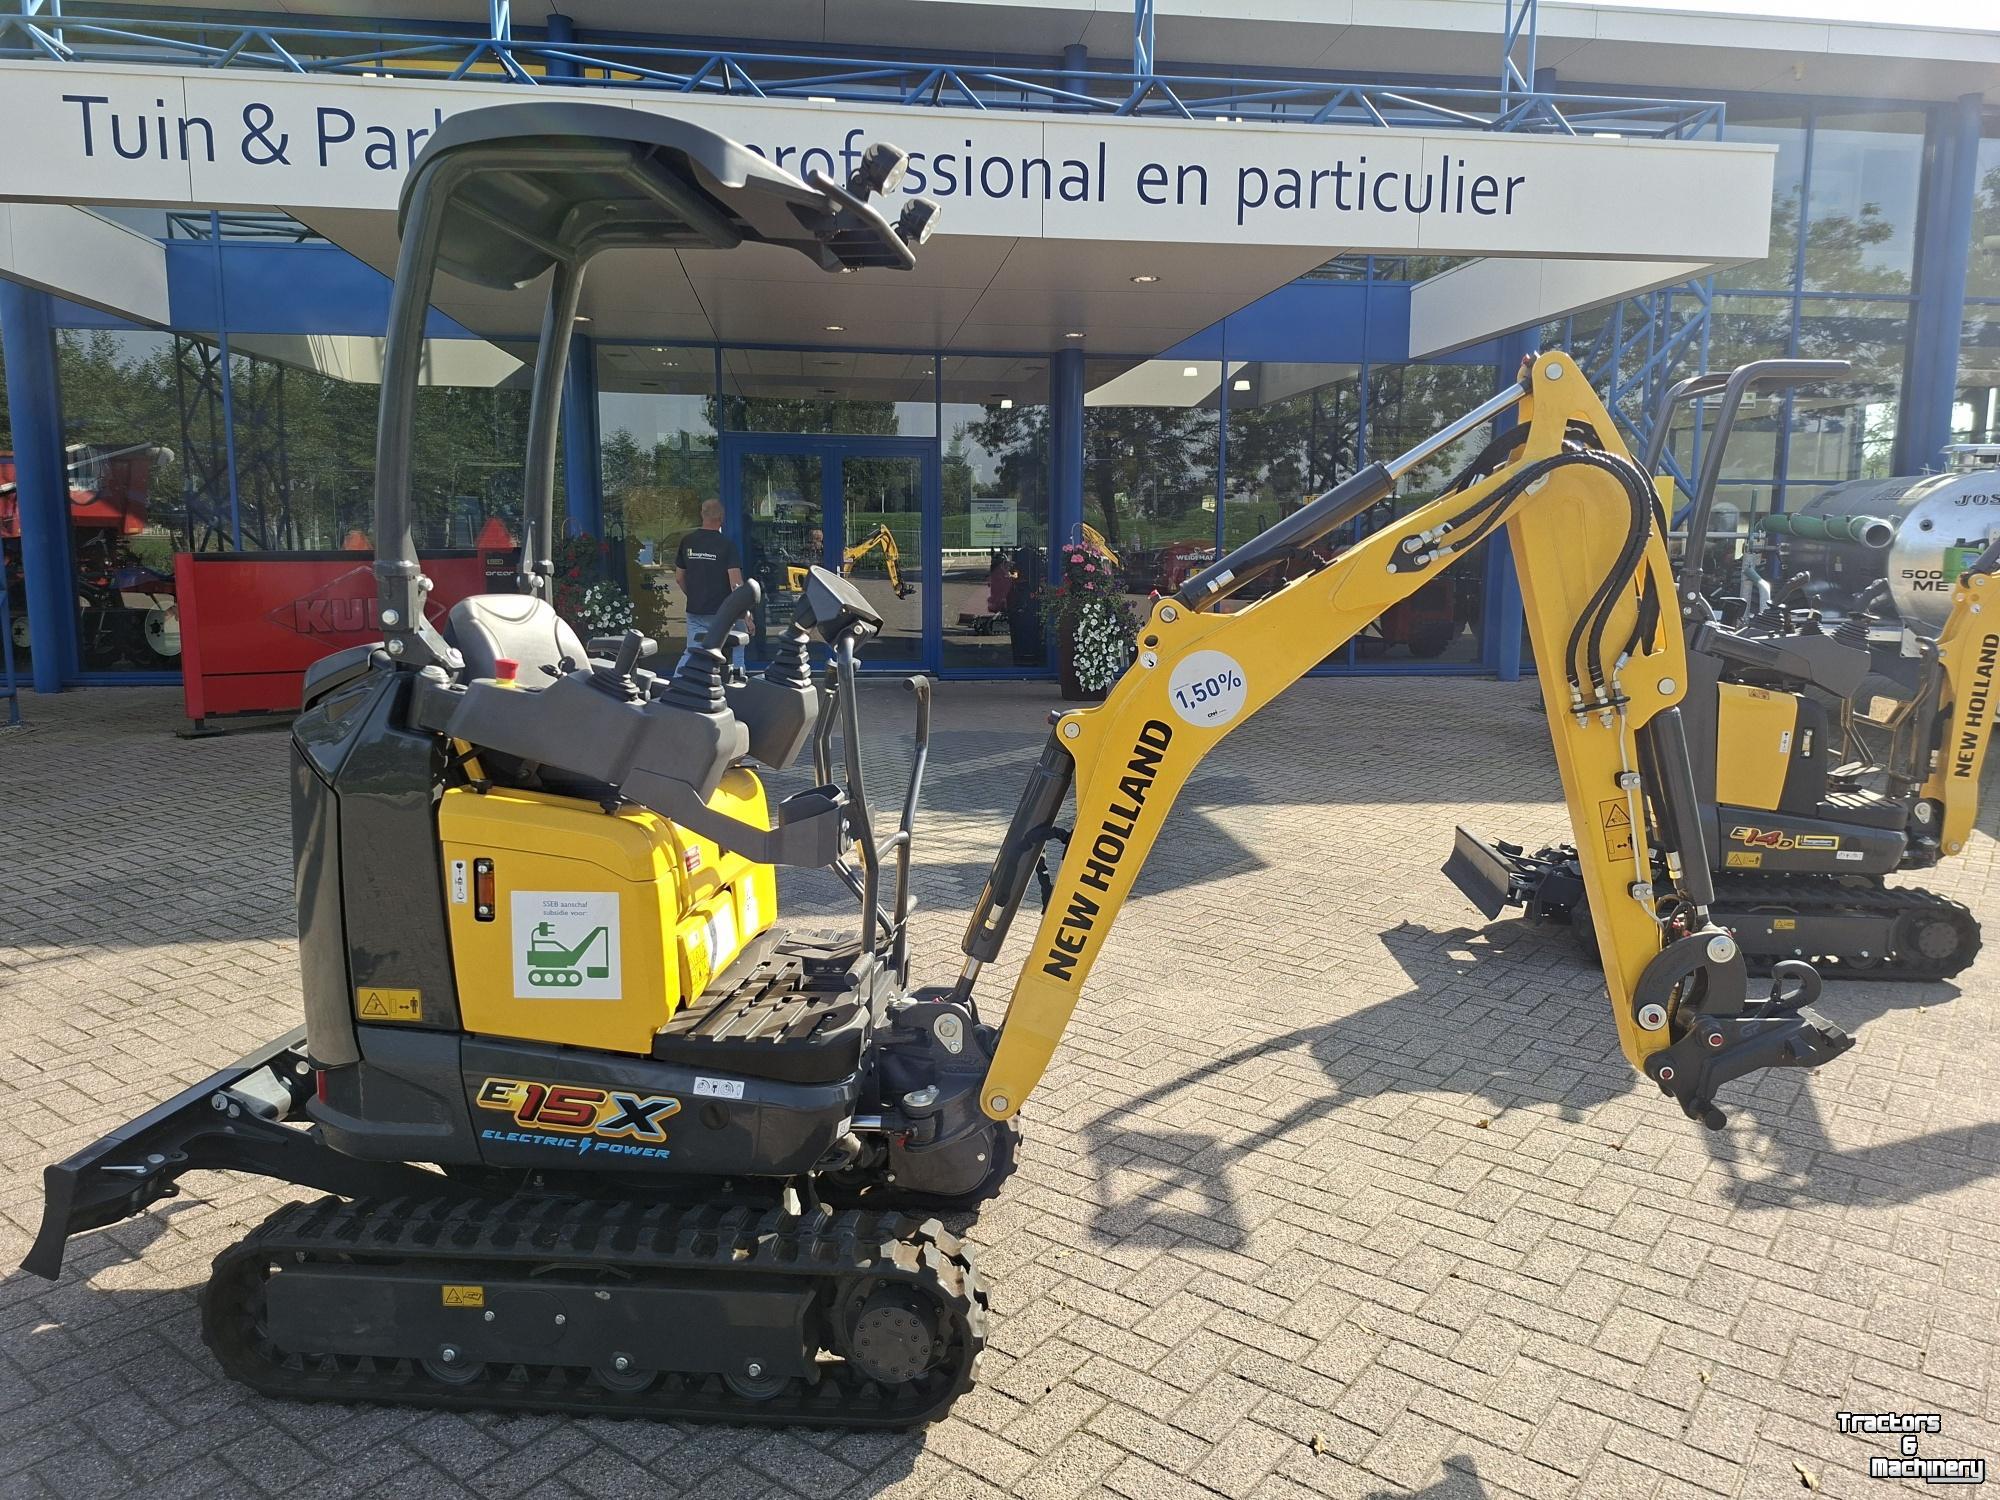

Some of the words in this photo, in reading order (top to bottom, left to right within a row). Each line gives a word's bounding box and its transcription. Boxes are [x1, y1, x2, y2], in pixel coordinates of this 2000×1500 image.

[62, 94, 215, 162] Tuin
[241, 102, 292, 166] &
[1137, 160, 1208, 206] en
[1237, 154, 1525, 226] particulier
[1901, 569, 1943, 580] 500
[1912, 580, 1949, 592] ME
[1176, 670, 1242, 710] 1,50%
[1965, 633, 2000, 727] HOLLAND
[1954, 731, 1978, 778] NEW
[1042, 891, 1100, 982] NEW
[1079, 719, 1173, 892] HOLLAND
[481, 1129, 577, 1148] ELECTRIC
[594, 1142, 671, 1159] POWER
